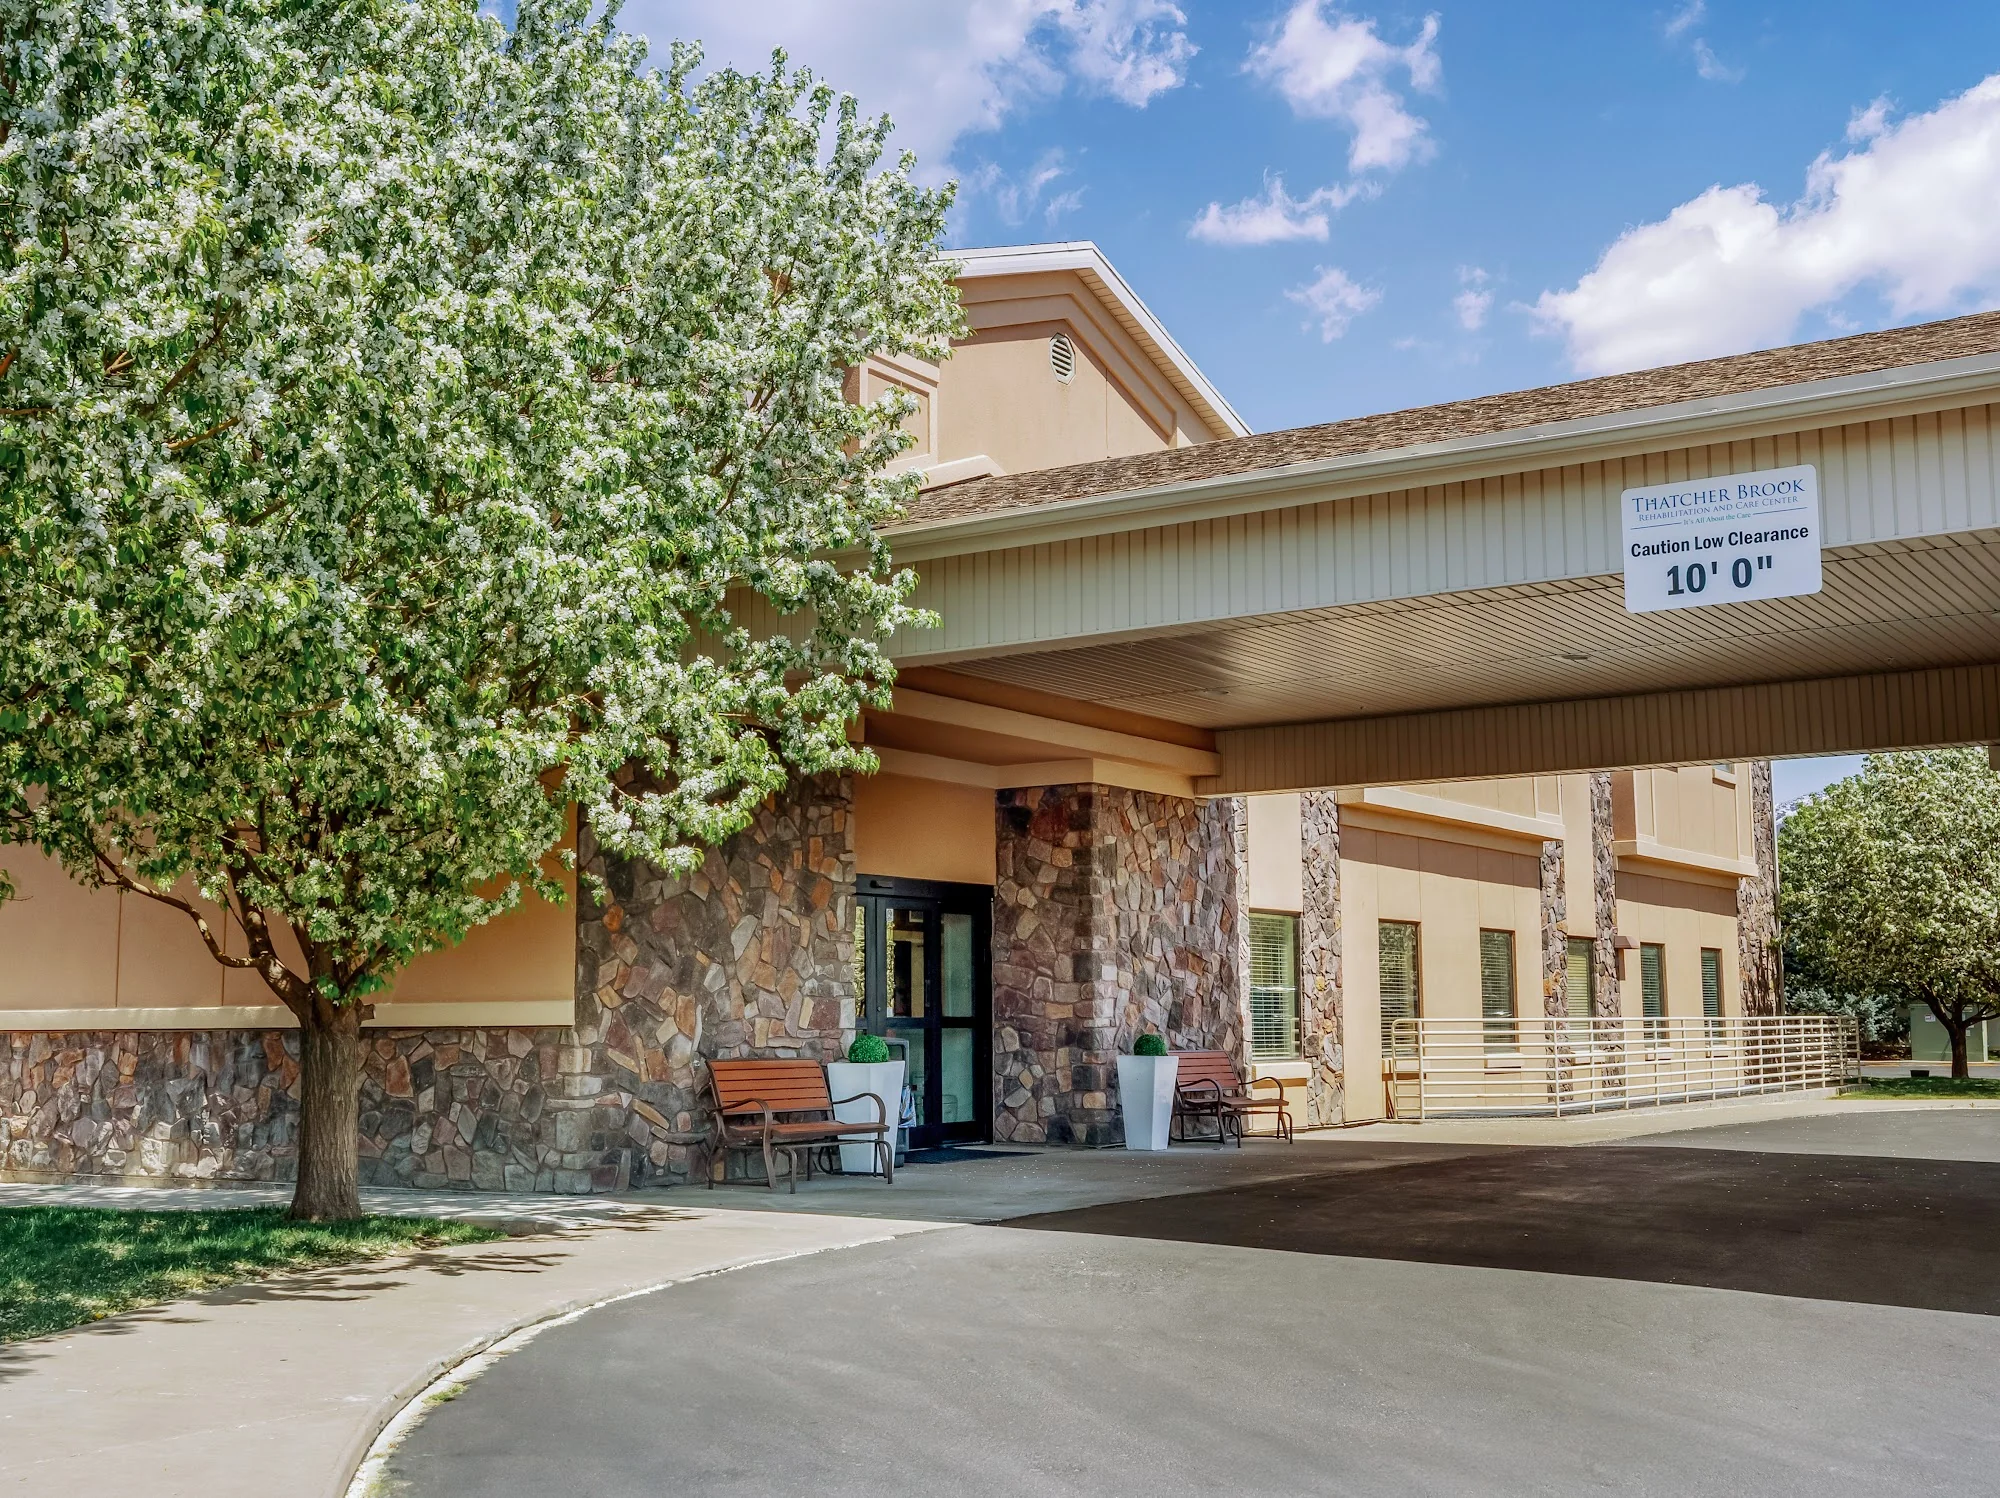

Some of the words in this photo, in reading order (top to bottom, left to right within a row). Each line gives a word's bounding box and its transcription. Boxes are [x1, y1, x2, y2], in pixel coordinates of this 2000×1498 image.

[1632, 488, 1730, 513] THATCHER
[1737, 478, 1806, 500] BROOK
[1639, 507, 1710, 522] REHABILITATION
[1713, 503, 1733, 513] AND
[1735, 500, 1759, 510] CARE
[1762, 496, 1798, 506] CENTER
[1706, 514, 1724, 523] About
[1631, 539, 1689, 557] Caution
[1695, 535, 1724, 550] Low
[1728, 526, 1809, 546] Clearance
[1667, 562, 1718, 596] 10'
[1732, 555, 1772, 589] 0"
